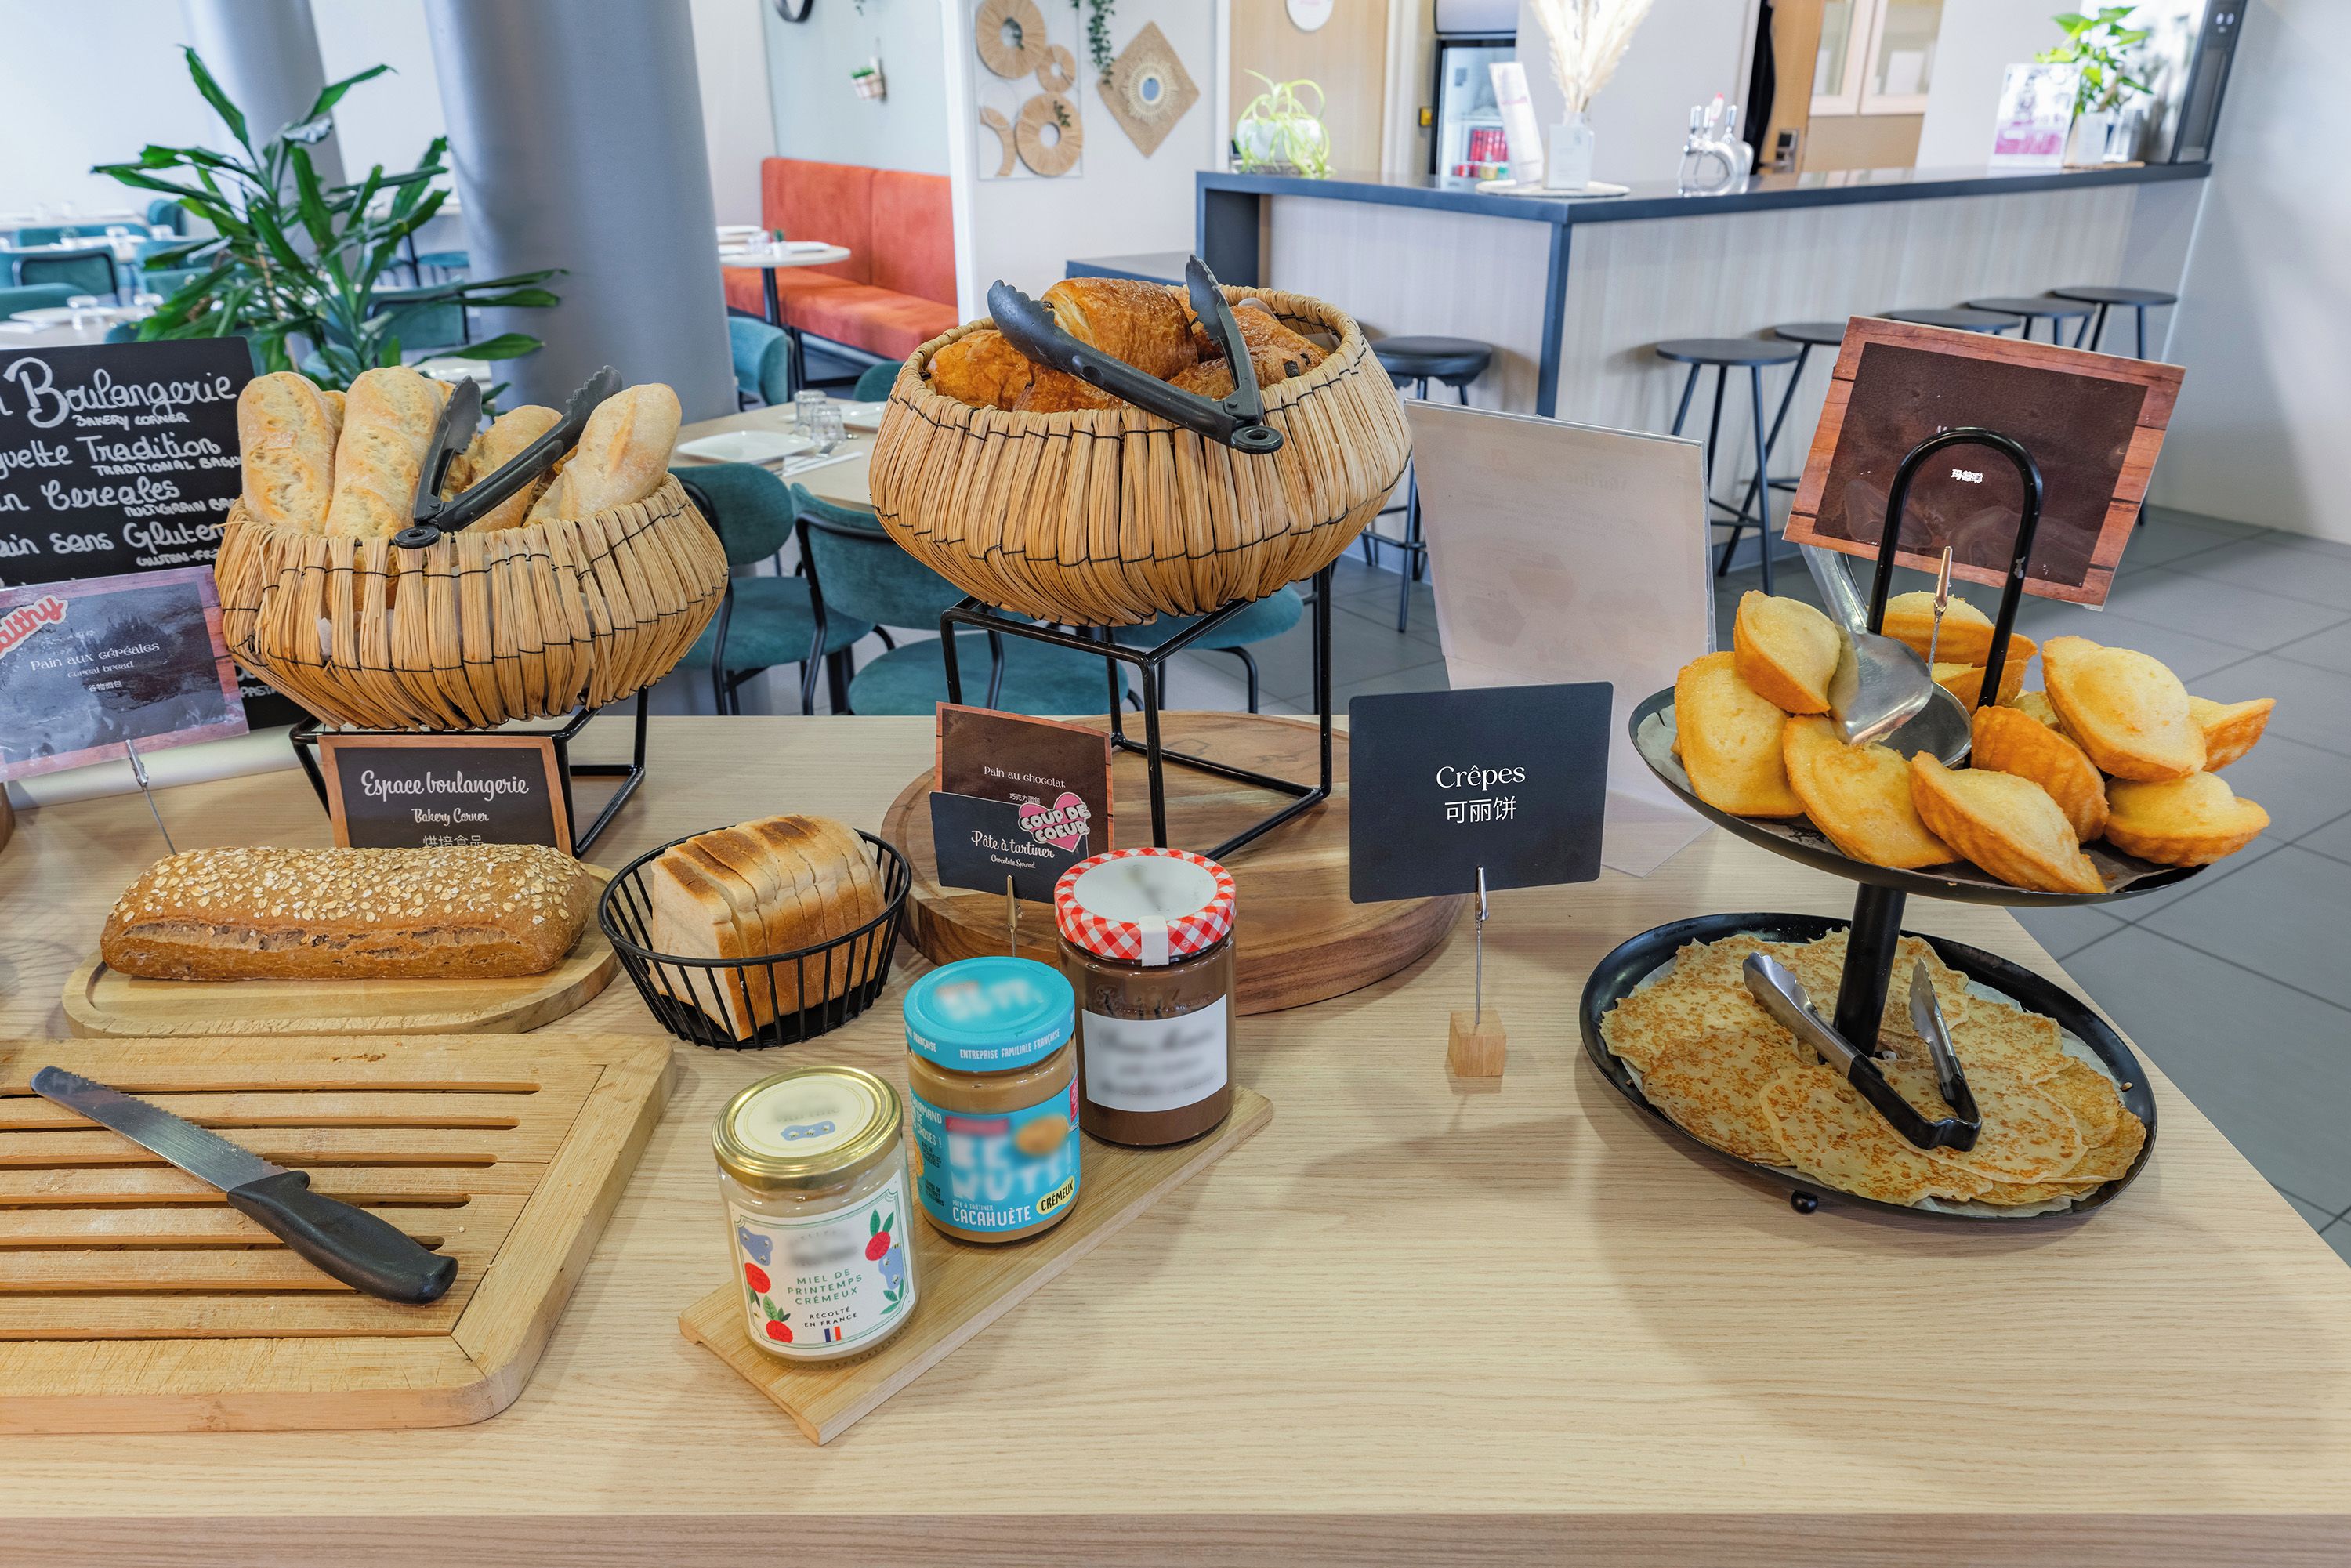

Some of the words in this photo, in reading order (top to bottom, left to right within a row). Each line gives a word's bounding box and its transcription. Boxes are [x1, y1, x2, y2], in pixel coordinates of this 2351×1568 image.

[3, 357, 237, 428] Boulangerie
[72, 415, 130, 431] BAKERY
[75, 431, 222, 462] Tradition
[90, 460, 196, 476] TRADITIONAL
[123, 521, 225, 554] Gluten
[31, 657, 63, 672] Pain
[67, 654, 95, 666] aux
[103, 661, 135, 672] bread
[360, 770, 425, 802] Espace
[426, 770, 529, 802] boulangerie
[984, 766, 1005, 778] Pain
[1007, 771, 1020, 780] au
[1023, 773, 1066, 788] chocolat
[1436, 765, 1526, 791] Crêpes
[411, 808, 451, 826] Bakery
[453, 807, 490, 824] Corner
[1020, 809, 1064, 830] COUP
[1064, 803, 1090, 820] DE
[1444, 795, 1517, 824] 可丽饼
[1034, 820, 1089, 842] COEUR
[970, 830, 1000, 850] Pâte
[1001, 838, 1009, 852] à
[1009, 838, 1055, 859] tartiner
[991, 853, 1016, 866] Chocolate
[1016, 859, 1036, 869] Spread
[959, 1048, 998, 1059] ENTREPRISE
[1001, 1043, 1031, 1058] FAMILIALE
[1034, 1028, 1060, 1049] FRANÇAISE
[1041, 1179, 1074, 1211] CRÉMEUX
[952, 1206, 1031, 1227] CACAHUÈTE
[788, 1274, 862, 1295] PRINTEMPS
[797, 1275, 828, 1285] MIEL
[835, 1268, 850, 1280] DE
[795, 1286, 858, 1305] CRÉMEUX
[809, 1306, 850, 1320] RÉCOLTÉ
[820, 1313, 857, 1326] FRANCE
